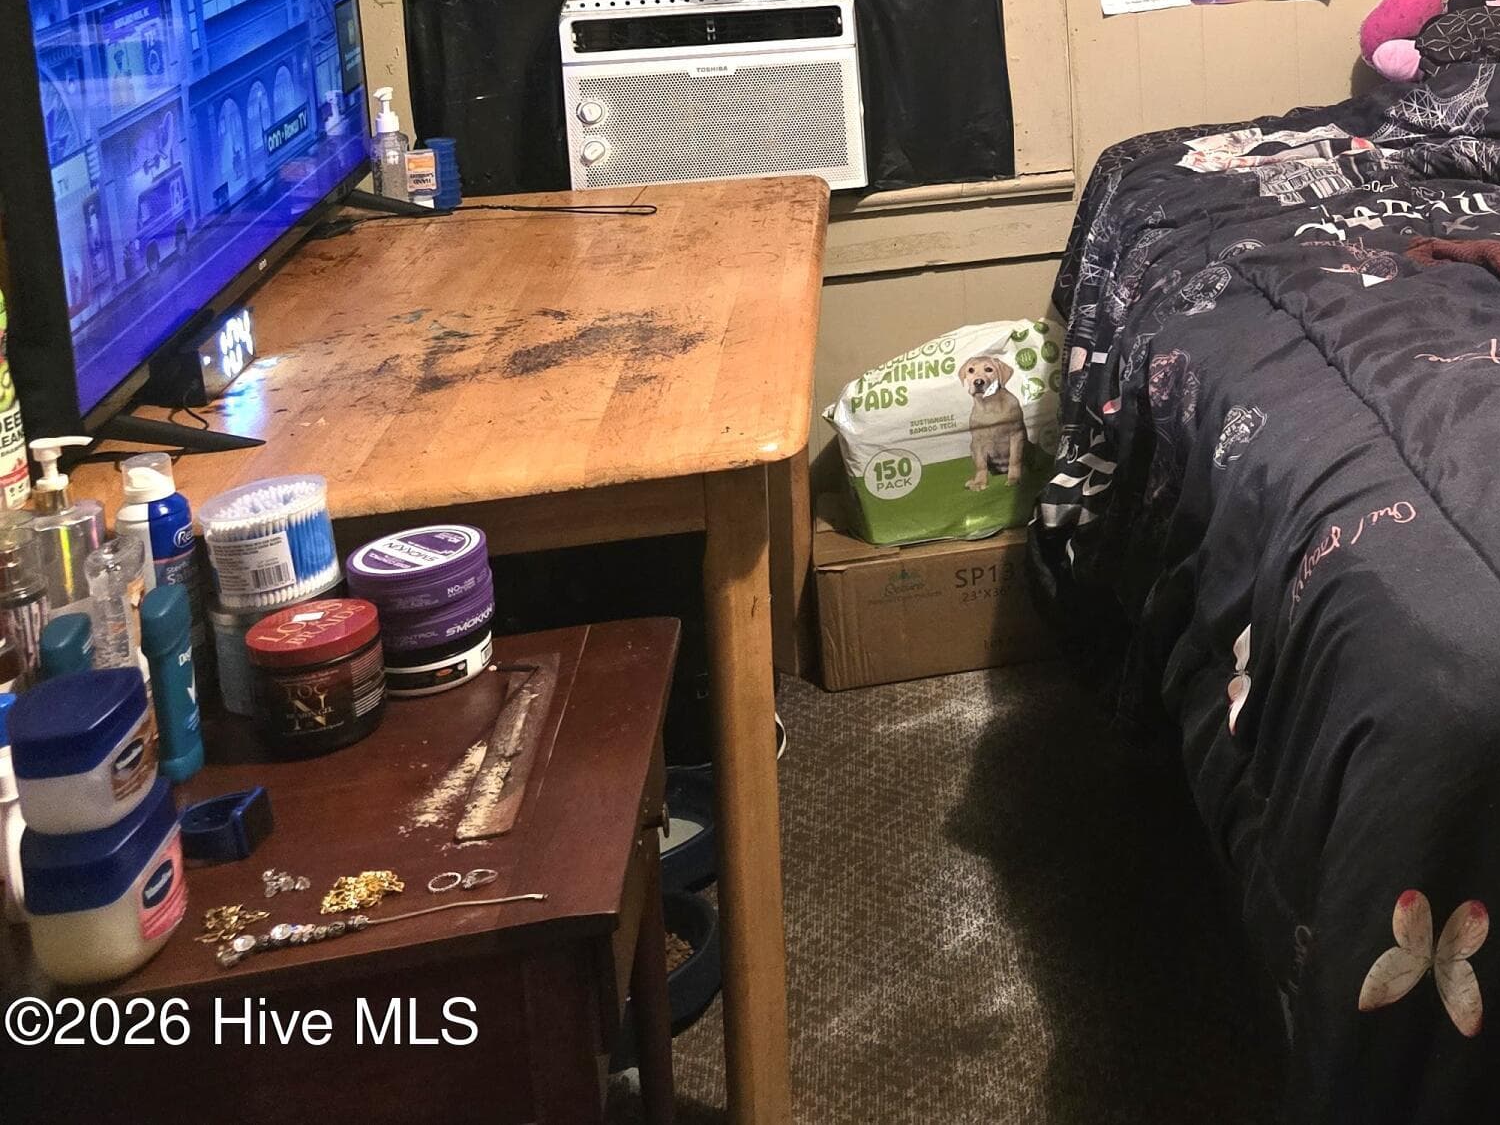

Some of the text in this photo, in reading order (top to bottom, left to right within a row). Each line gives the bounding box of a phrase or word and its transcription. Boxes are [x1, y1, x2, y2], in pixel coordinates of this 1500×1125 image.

[866, 338, 956, 373] BOO
[851, 386, 909, 414] PADS
[873, 457, 913, 482] 150
[876, 477, 913, 492] PACK
[257, 601, 343, 643] LOS
[285, 605, 366, 645] BRAIDS
